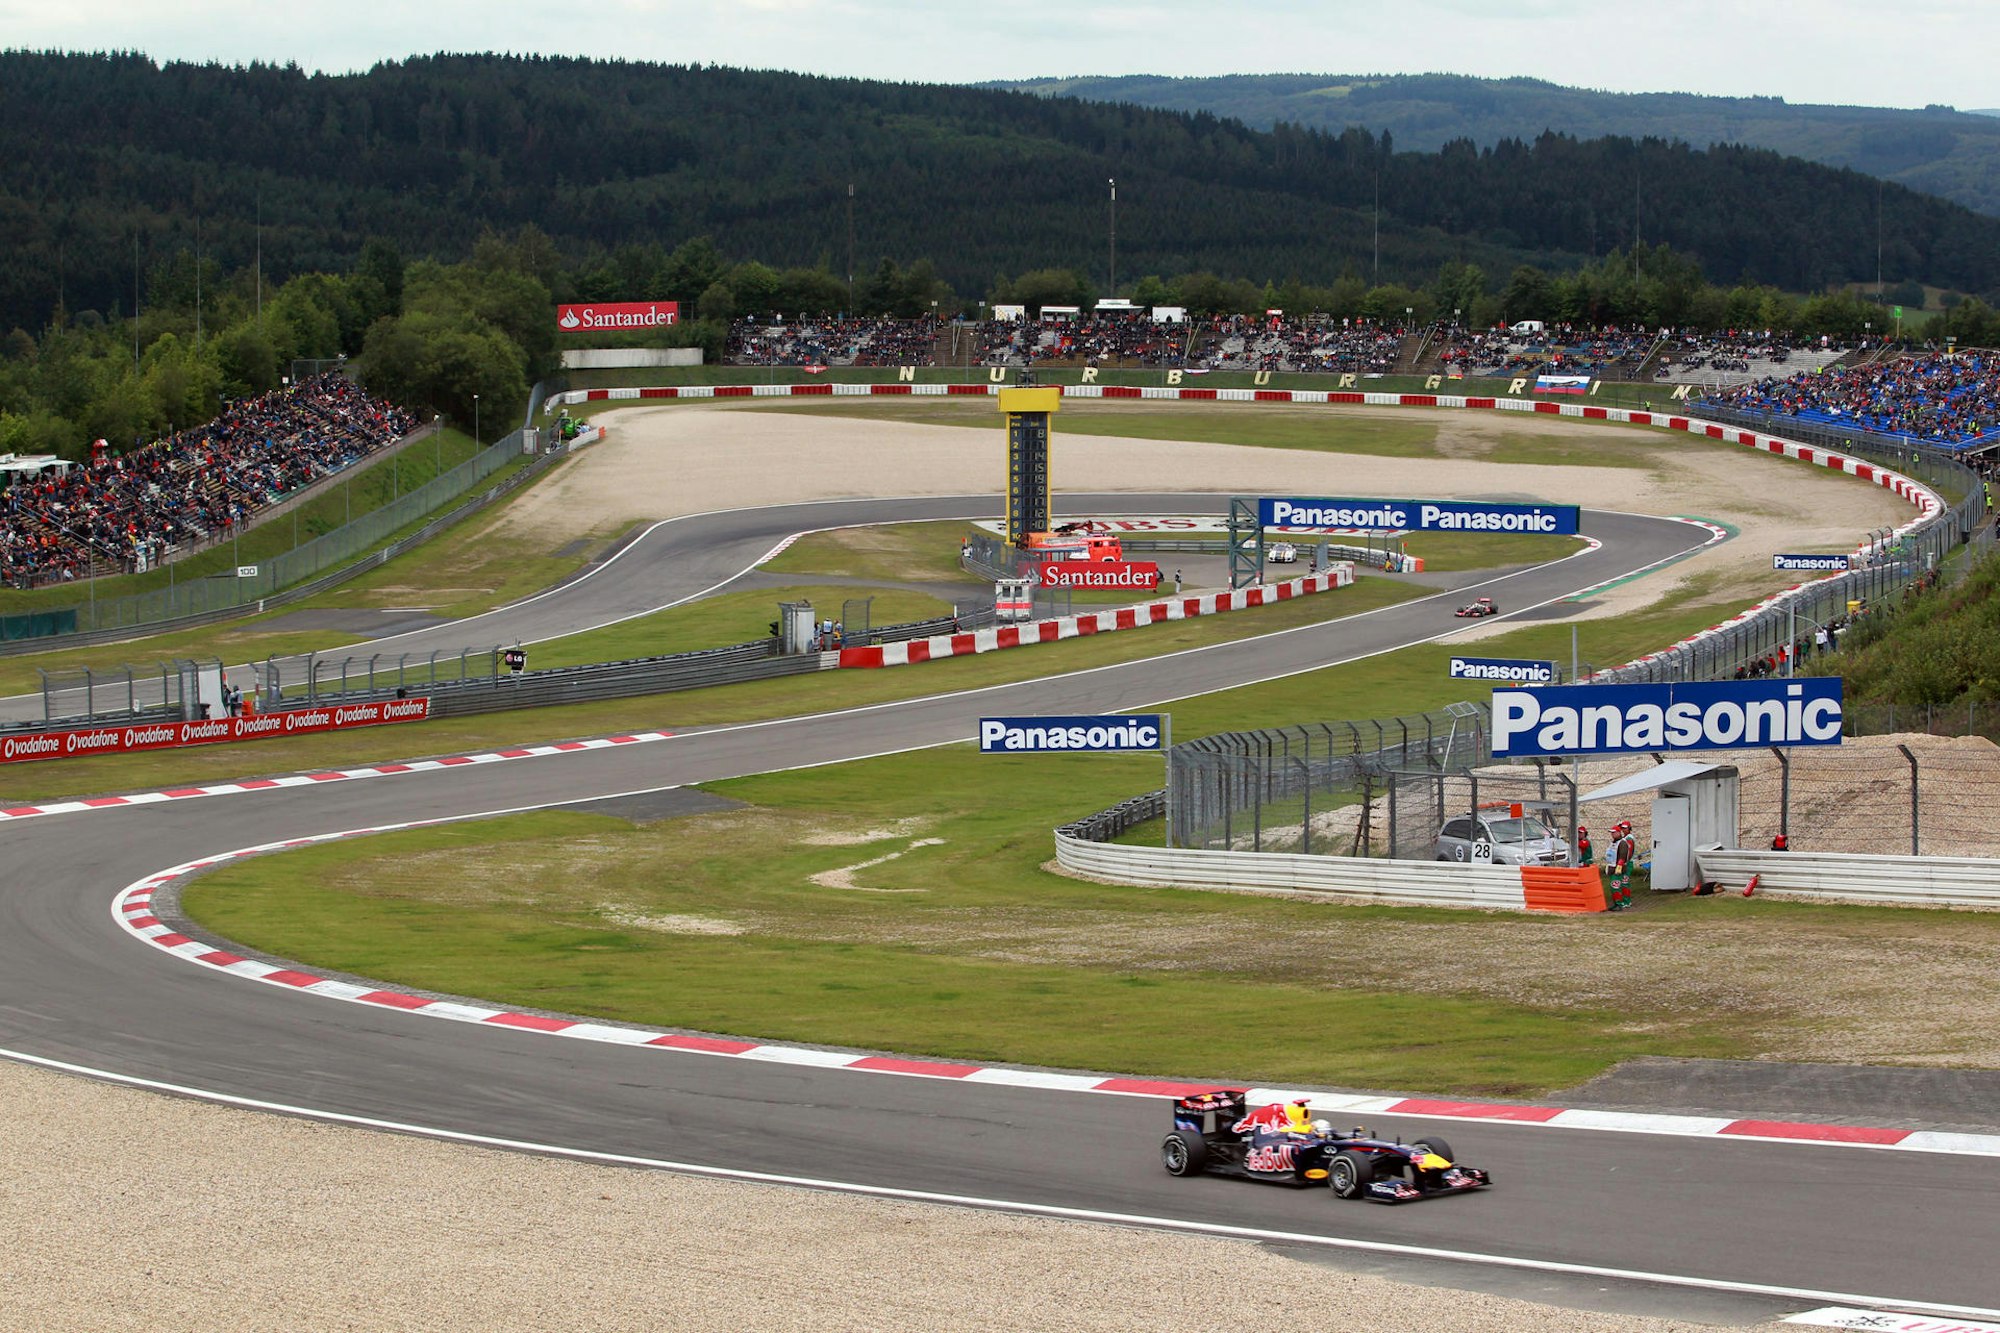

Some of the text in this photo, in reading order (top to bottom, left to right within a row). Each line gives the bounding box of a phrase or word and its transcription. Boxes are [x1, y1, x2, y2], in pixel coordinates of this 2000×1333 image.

[582, 305, 675, 328] Santander
[1273, 501, 1556, 532] Panasonic Panasonic
[1774, 556, 1848, 569] Panasonic
[1045, 564, 1154, 587] Santander
[1450, 659, 1551, 681] Panasonic
[15, 700, 424, 754] vodafone vodafone vodafone vodafone vodafone vodafone vodafone vodafone
[1492, 683, 1843, 752] Panasonic
[981, 719, 1158, 749] Panasonic
[1474, 843, 1490, 858] 28
